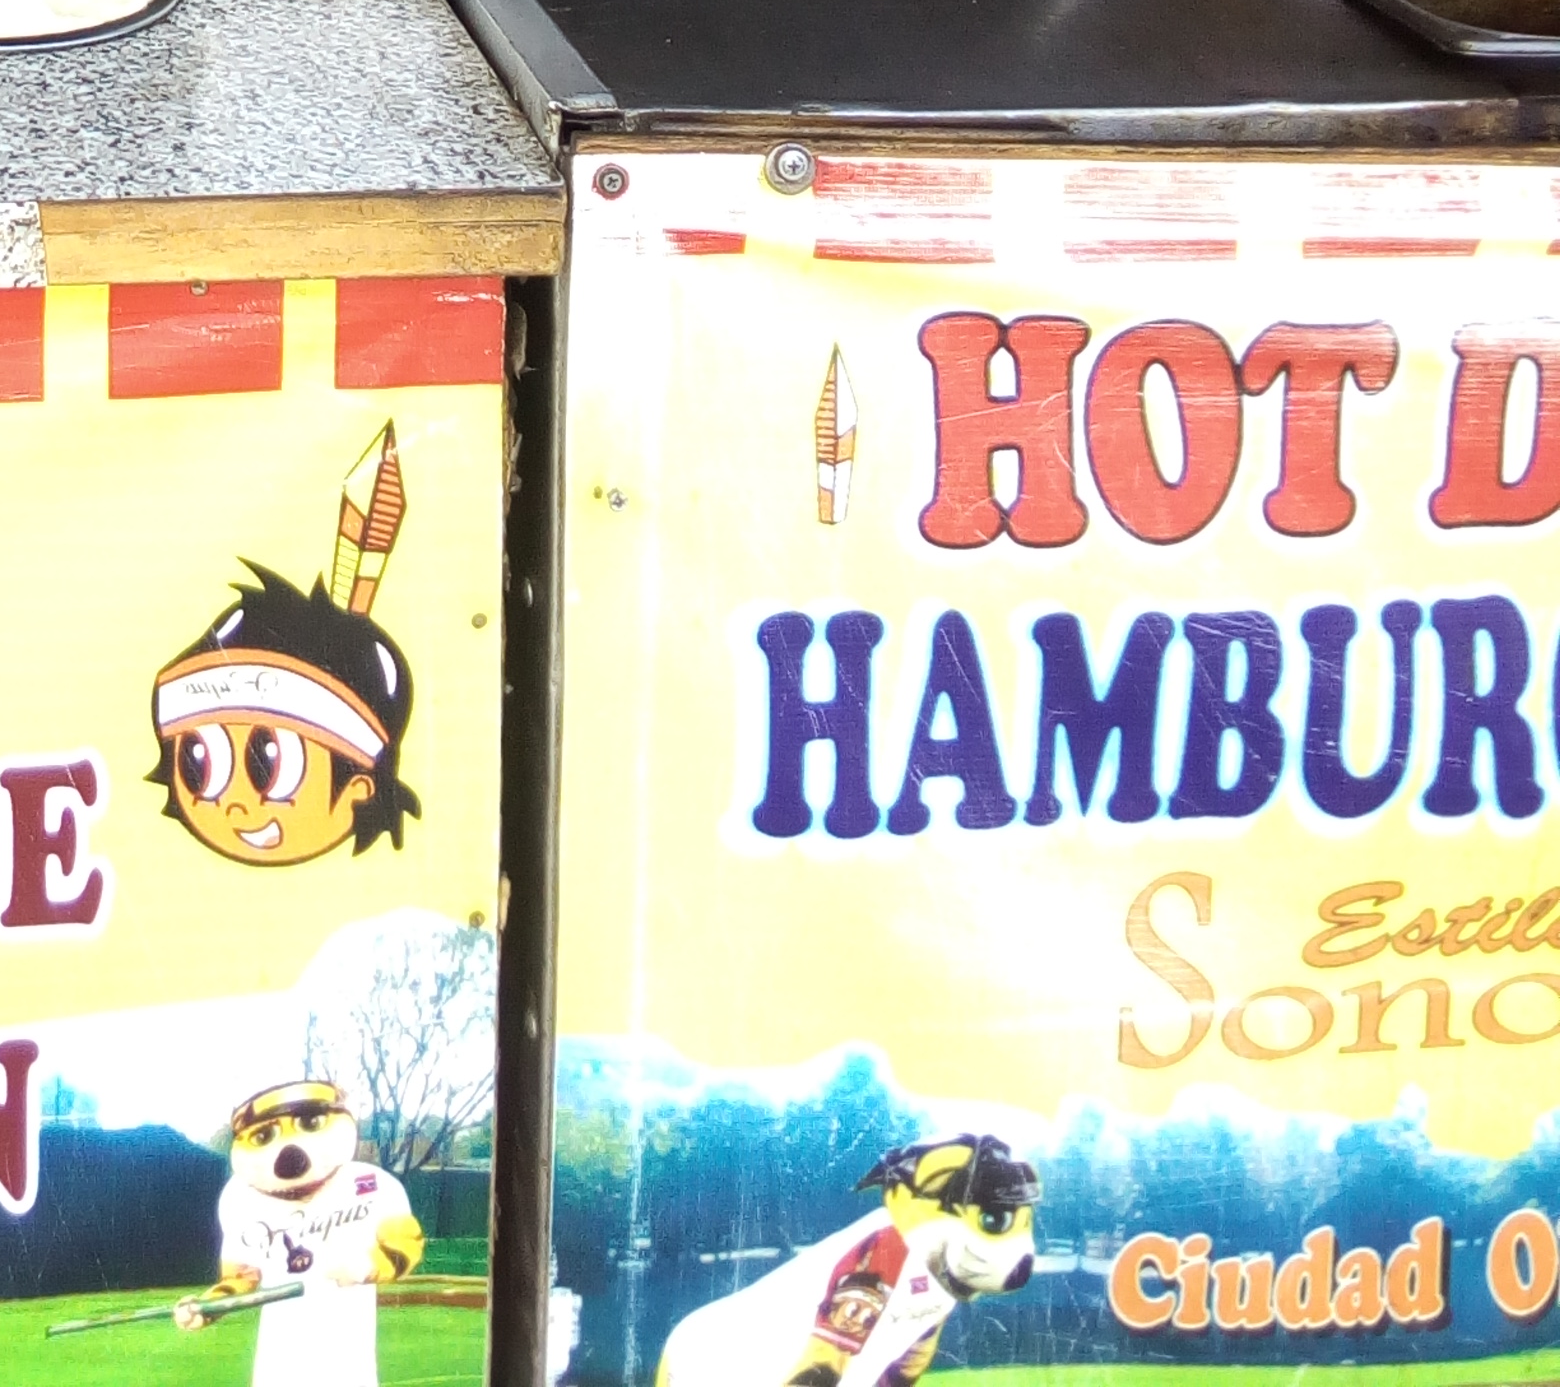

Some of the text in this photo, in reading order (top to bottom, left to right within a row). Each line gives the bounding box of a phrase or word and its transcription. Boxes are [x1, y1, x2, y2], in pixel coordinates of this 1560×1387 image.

[918, 312, 1400, 549] HOT
[752, 594, 1560, 840] HAMBUR
[1109, 1216, 1445, 1328] Ciudad
